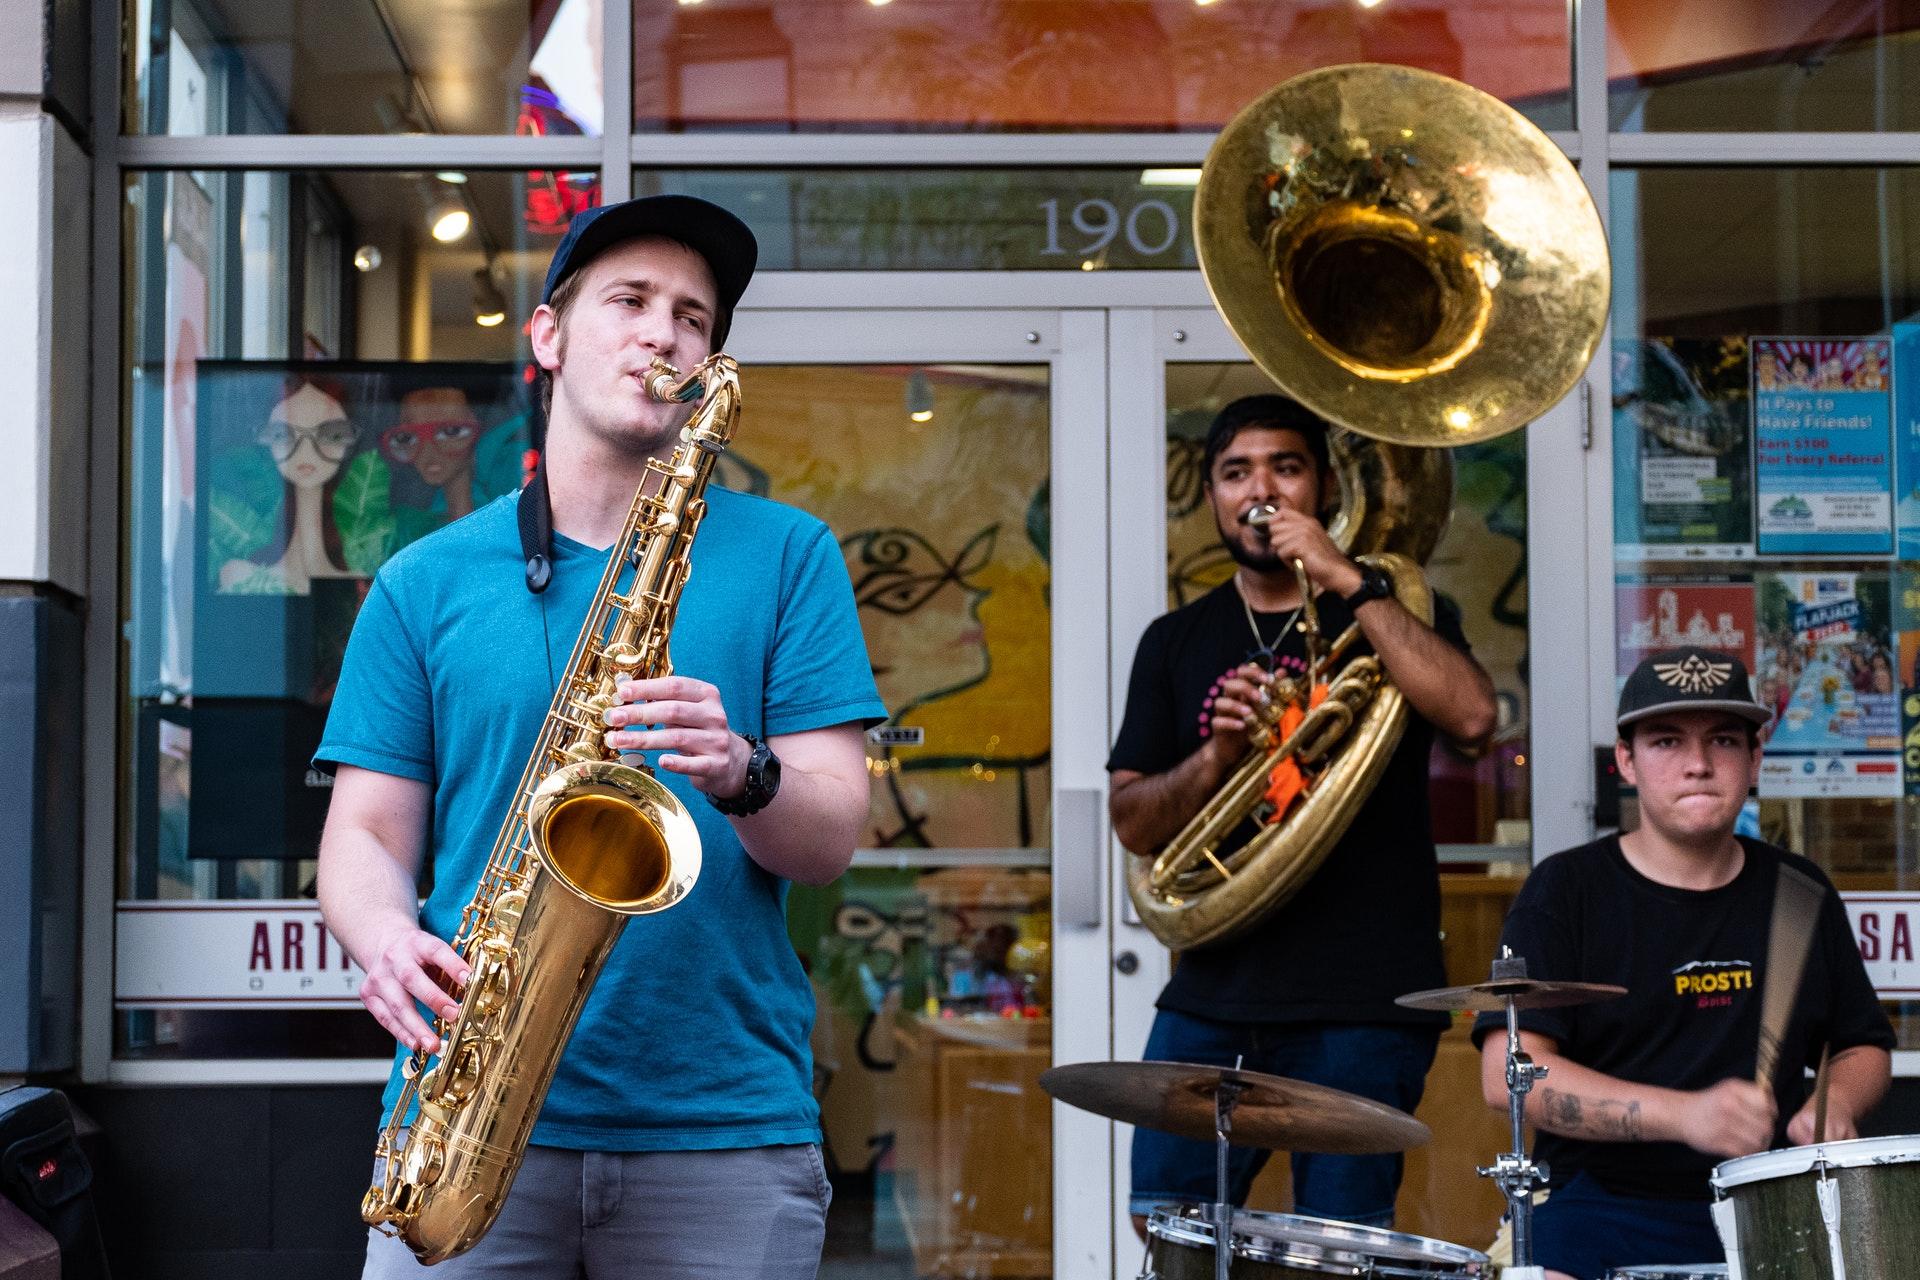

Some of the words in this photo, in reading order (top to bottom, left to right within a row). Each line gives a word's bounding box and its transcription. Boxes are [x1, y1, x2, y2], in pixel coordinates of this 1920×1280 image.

[1039, 198, 1179, 255] 190
[1775, 397, 1812, 413] Pays
[1816, 399, 1835, 411] to
[1758, 415, 1801, 428] Have
[1804, 414, 1873, 429] Friends!
[1785, 454, 1824, 466] Every
[1828, 454, 1884, 465] Referral
[1675, 970, 1753, 995] PROST!
